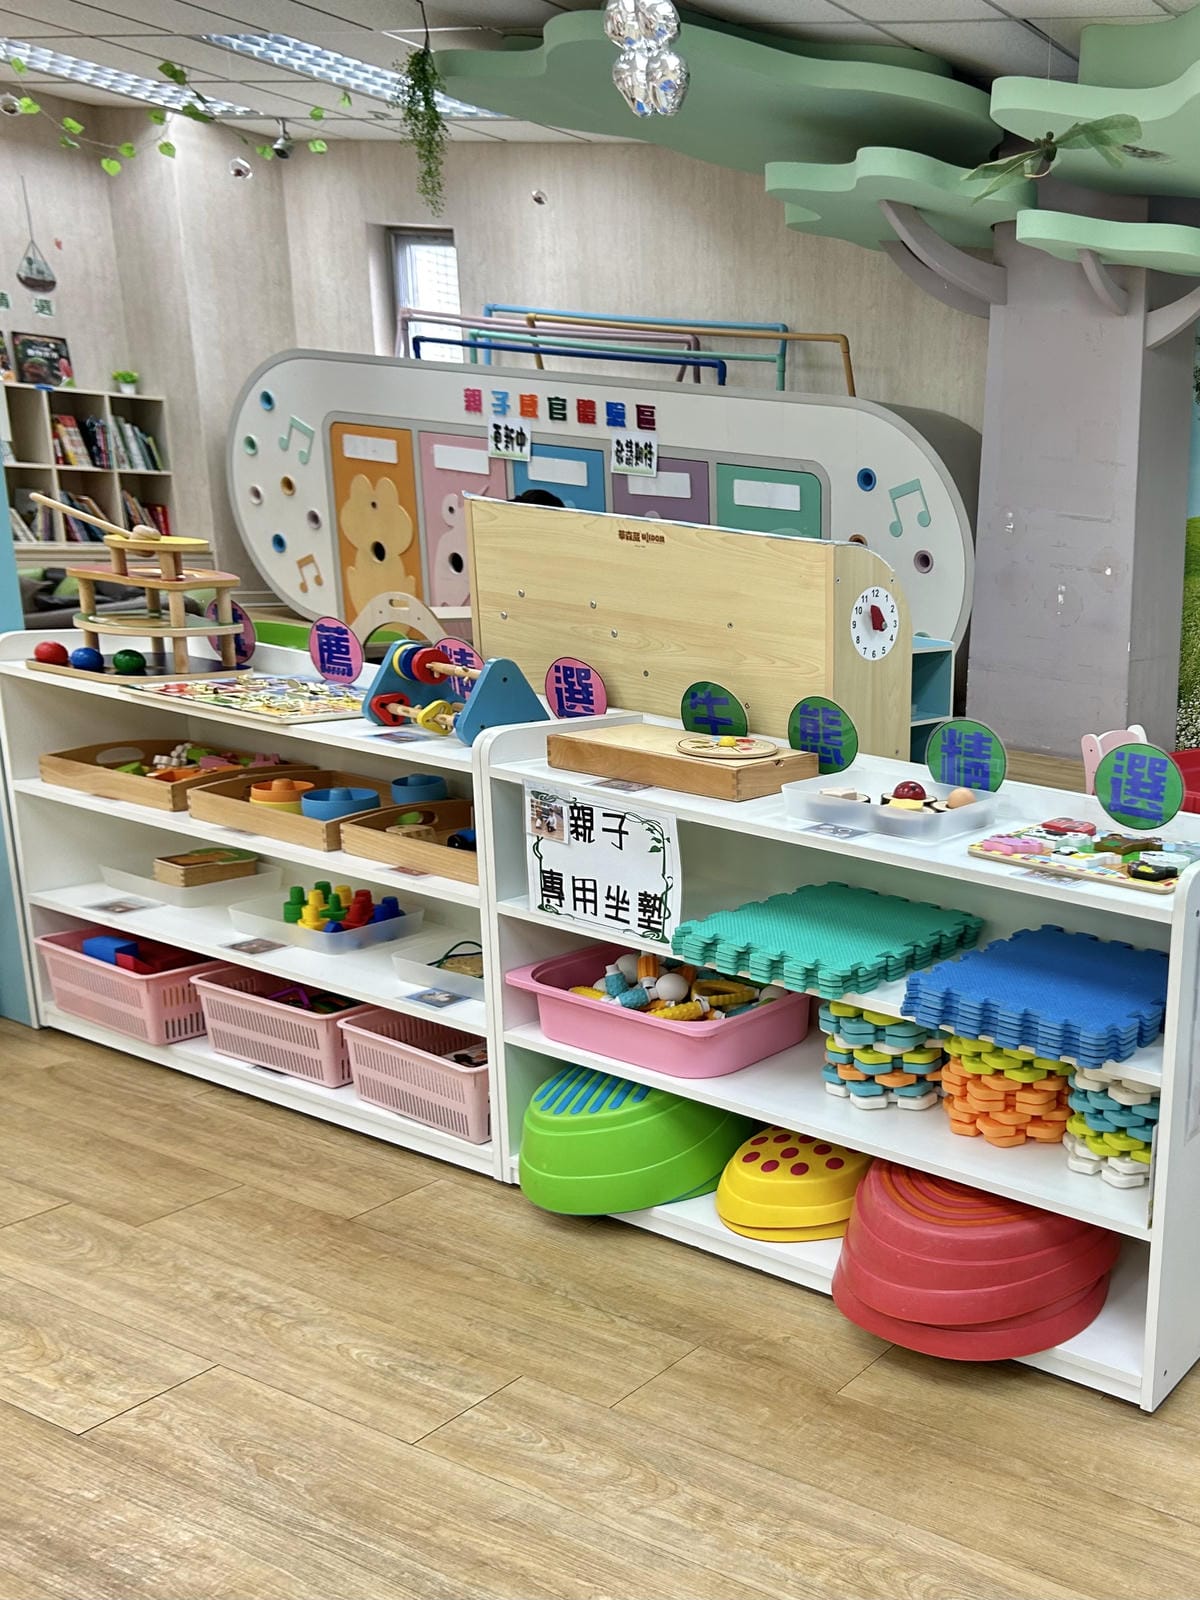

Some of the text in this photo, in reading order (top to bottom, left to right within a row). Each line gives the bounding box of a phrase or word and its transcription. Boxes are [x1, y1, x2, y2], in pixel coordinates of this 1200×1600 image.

[871, 589, 880, 598] 12
[861, 595, 868, 603] 11
[885, 594, 889, 602] 1
[855, 606, 863, 615] 10
[890, 605, 895, 613] 2
[852, 620, 857, 629] 9
[893, 620, 898, 628] 3
[856, 636, 860, 644] 8
[889, 634, 894, 642] 4
[863, 647, 867, 655] 7
[872, 650, 877, 658] 6
[881, 646, 886, 655] 5
[316, 622, 353, 677] 薦
[554, 664, 595, 718] 選
[941, 728, 993, 790] 精
[1109, 751, 1168, 824] 選
[569, 803, 630, 851] 親子
[541, 868, 664, 934] 專用坐墊
